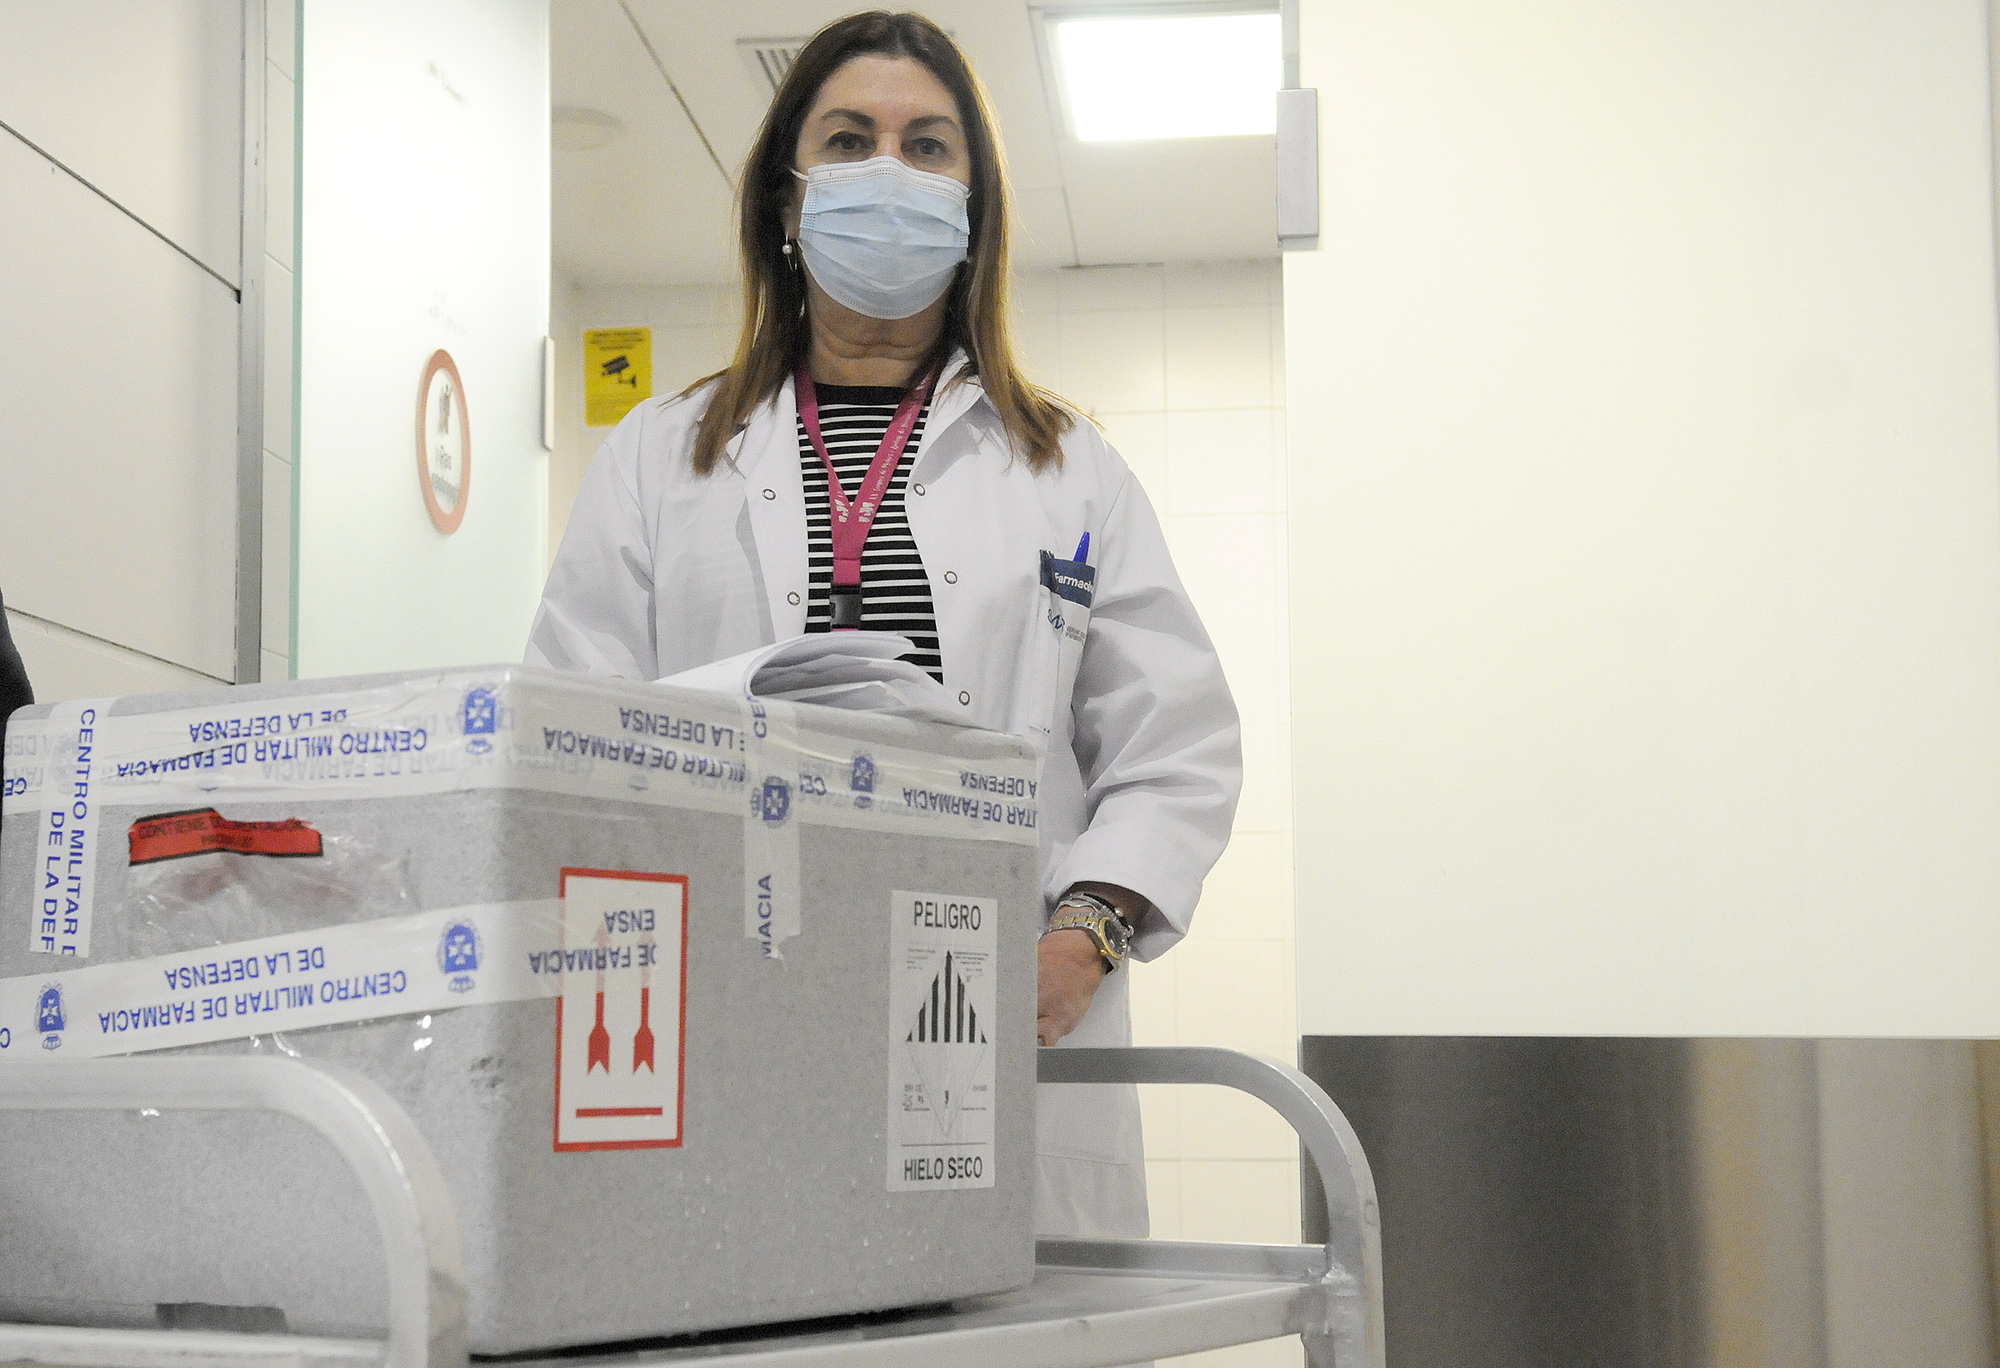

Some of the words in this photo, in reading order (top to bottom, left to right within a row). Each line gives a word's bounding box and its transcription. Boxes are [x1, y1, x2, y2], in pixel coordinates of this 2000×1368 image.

[189, 715, 281, 743] DEFENSA
[287, 712, 313, 730] LA
[320, 709, 347, 723] DE
[619, 706, 706, 744] DEFENSA
[254, 735, 333, 762] MILITAR
[339, 728, 428, 755] CENTRO
[542, 726, 646, 765] FARMACIA
[711, 725, 735, 749] LA
[72, 708, 96, 821] CENTRO
[117, 749, 214, 777] FARMACIA
[221, 743, 247, 765] DE
[649, 746, 678, 770] DE
[960, 771, 1025, 798] DEFENSA
[902, 787, 979, 819] FARMACIA
[983, 802, 1002, 823] DE
[48, 811, 65, 846] DE
[45, 855, 61, 890] LA
[63, 829, 86, 934] MILITAR
[40, 898, 58, 953] DEF
[604, 909, 655, 934] ENSA
[914, 900, 981, 931] PELIGRO
[264, 951, 292, 976] LA
[297, 946, 325, 972] DE
[529, 946, 631, 974] FARMACIA
[164, 956, 260, 991] DEFENSA
[320, 970, 407, 1003] CENTRO
[202, 996, 228, 1020] DE
[235, 983, 314, 1015] MILITAR
[98, 1001, 195, 1034] FARMACIA
[904, 1158, 944, 1180] HIELO
[947, 1156, 983, 1179] SECO
